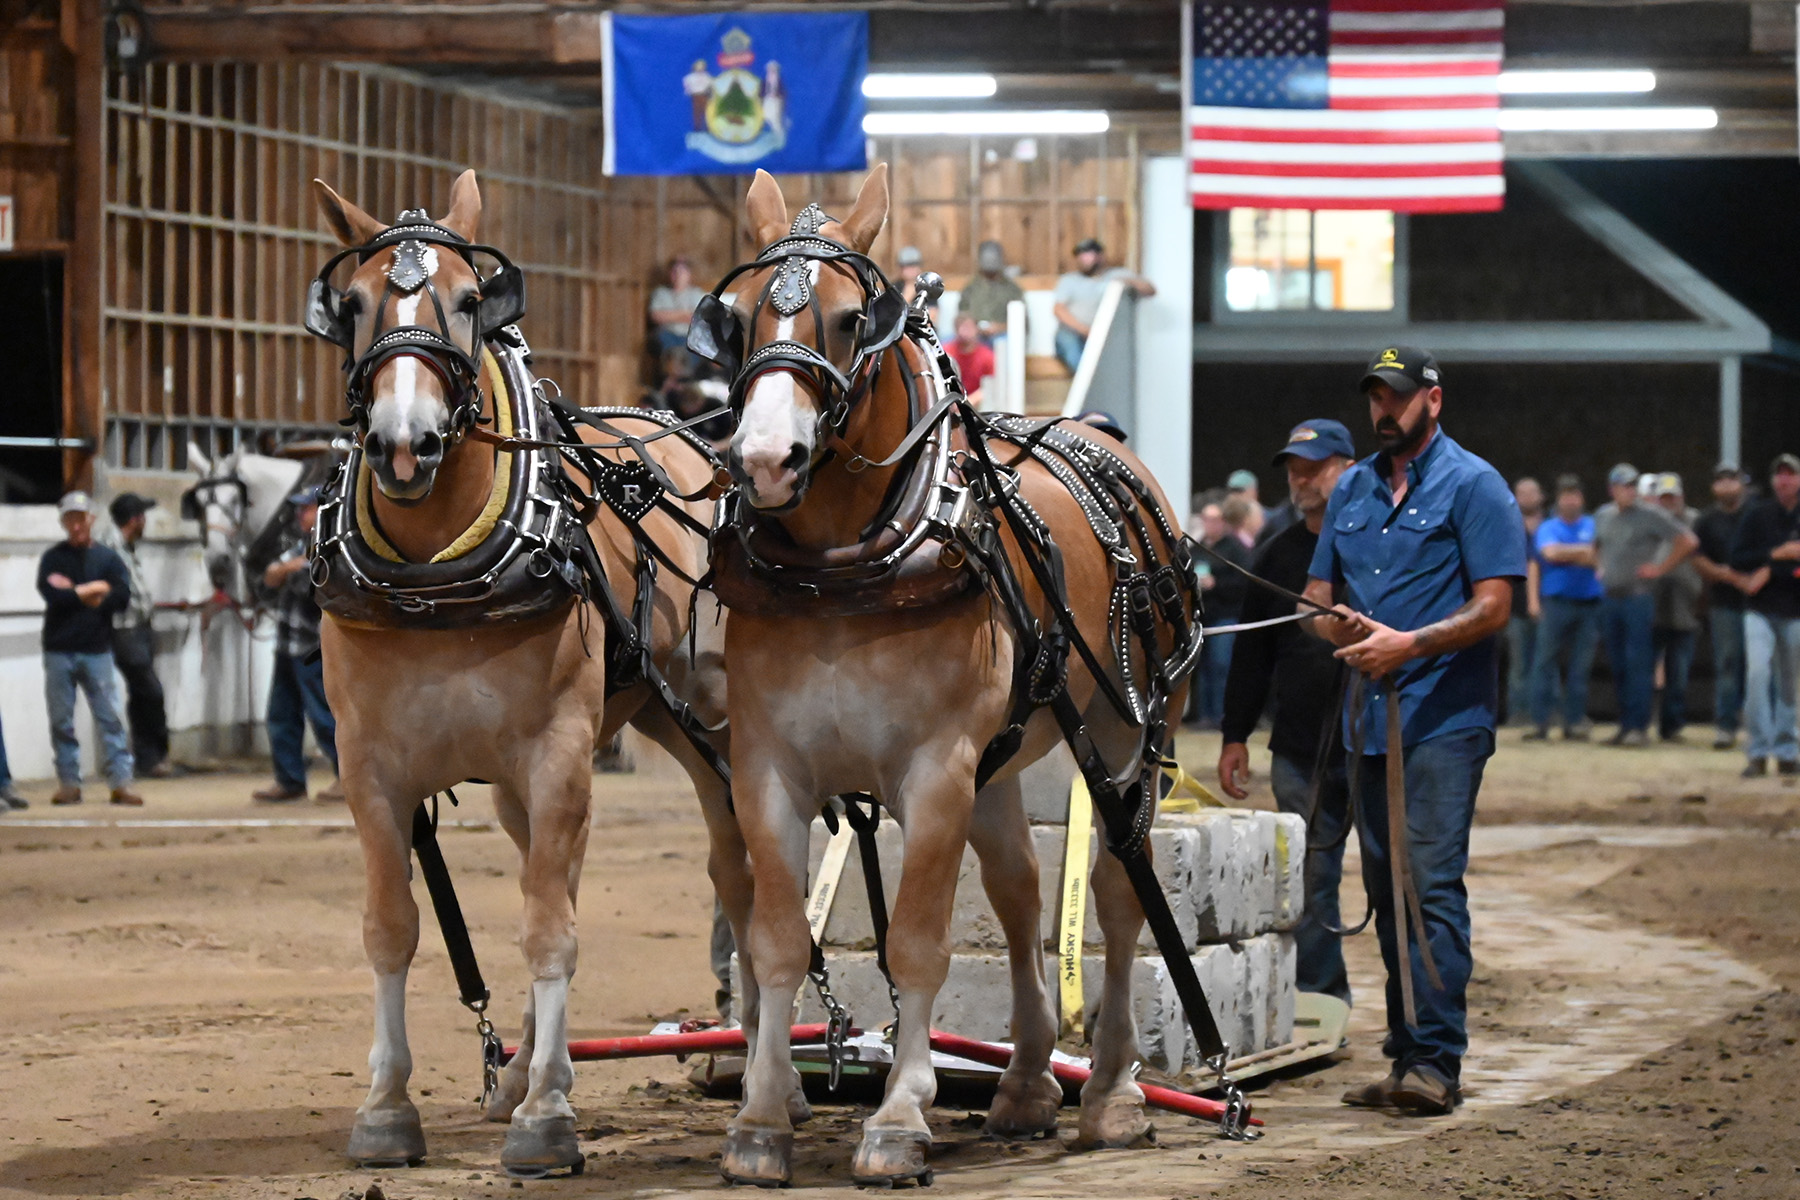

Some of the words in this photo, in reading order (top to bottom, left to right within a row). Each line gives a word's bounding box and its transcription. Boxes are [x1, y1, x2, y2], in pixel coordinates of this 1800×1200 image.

[622, 484, 643, 504] R
[1069, 911, 1077, 928] WLL
[1065, 933, 1075, 971] HUSKY
